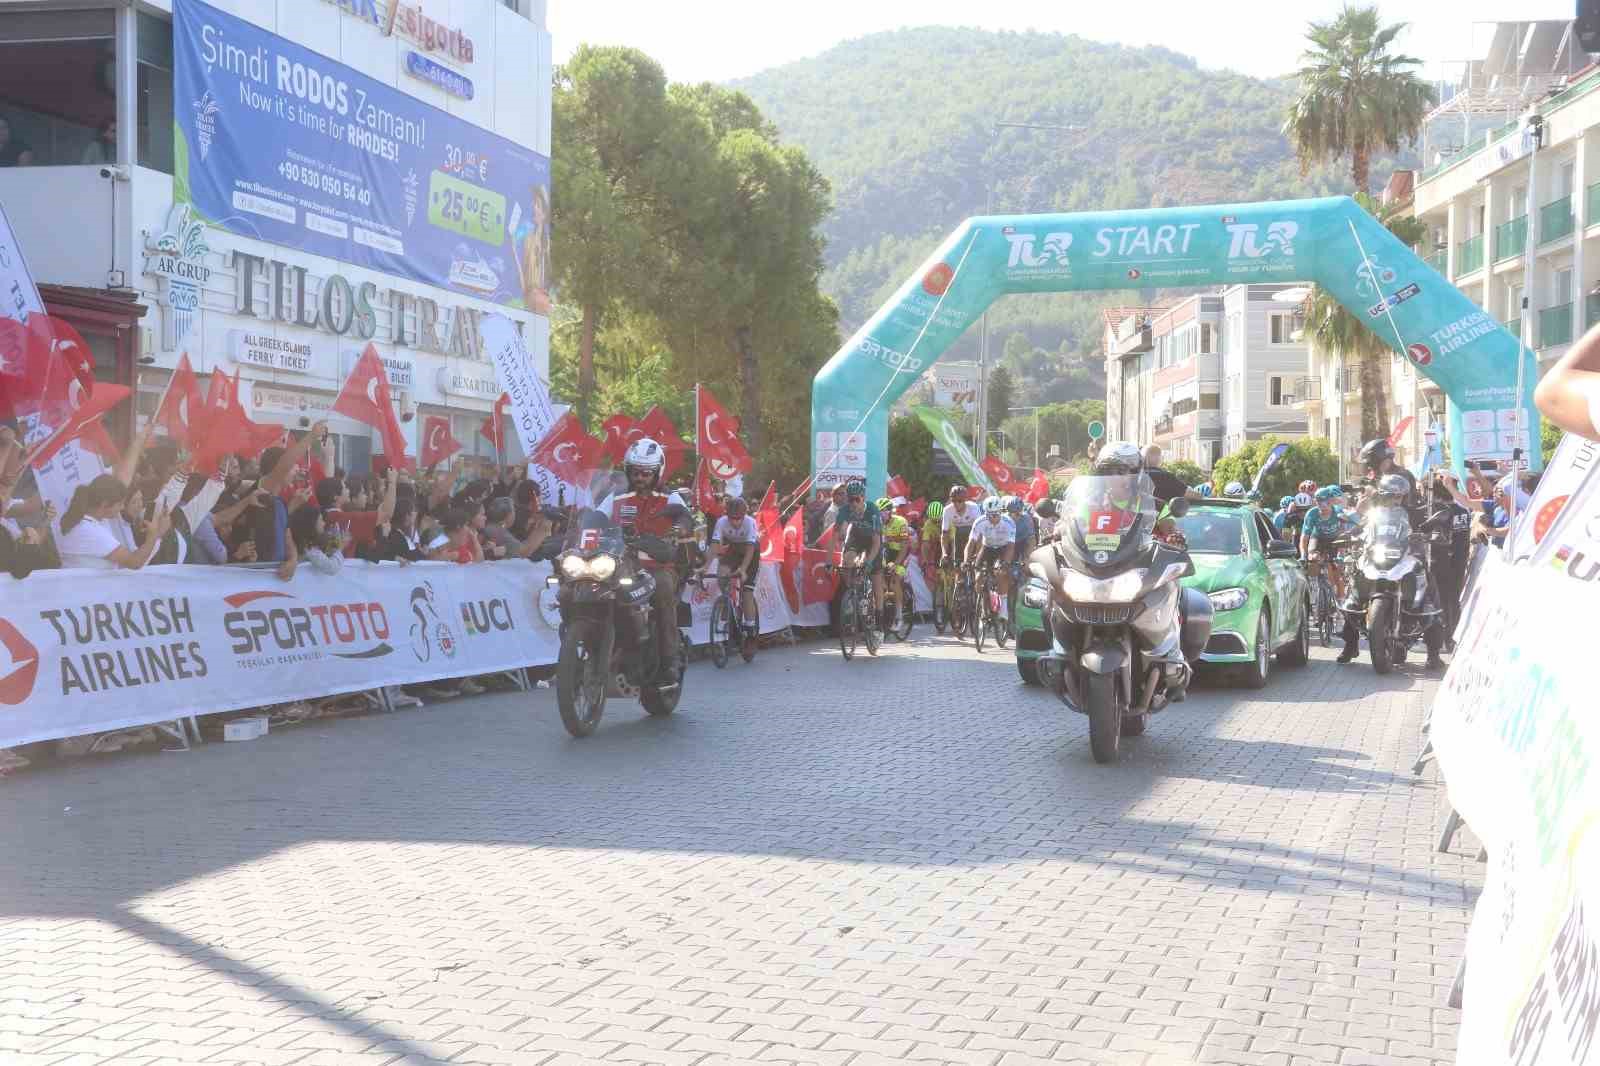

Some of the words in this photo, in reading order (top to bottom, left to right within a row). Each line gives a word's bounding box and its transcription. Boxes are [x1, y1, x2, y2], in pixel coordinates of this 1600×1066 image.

[202, 24, 268, 85] Şimdi
[276, 54, 349, 116] RODOS
[355, 89, 425, 151] Zamanı!
[240, 81, 272, 113] Now
[274, 94, 296, 122] it's
[298, 104, 326, 133] time
[328, 115, 345, 141] for
[347, 123, 399, 164] RHODES!
[278, 160, 299, 182] +90
[300, 166, 320, 189] 530
[321, 174, 341, 197] 050
[343, 181, 357, 201] 54
[357, 188, 371, 207] 40
[1092, 222, 1201, 257] START
[177, 260, 211, 283] GRUP
[243, 334, 259, 347] ALL
[259, 336, 282, 351] GREEK
[283, 341, 312, 357] ISLANDS
[1429, 311, 1489, 344] TURKISH
[1439, 320, 1498, 358] AIRLINES
[248, 349, 274, 365] FERRY
[279, 354, 308, 370] TICKET
[580, 528, 597, 549] F
[1096, 514, 1112, 531] F
[39, 596, 195, 646] TURKISH
[223, 601, 390, 655] SPORTOTO
[474, 598, 515, 634] UCI
[59, 640, 209, 696] AIRLINES
